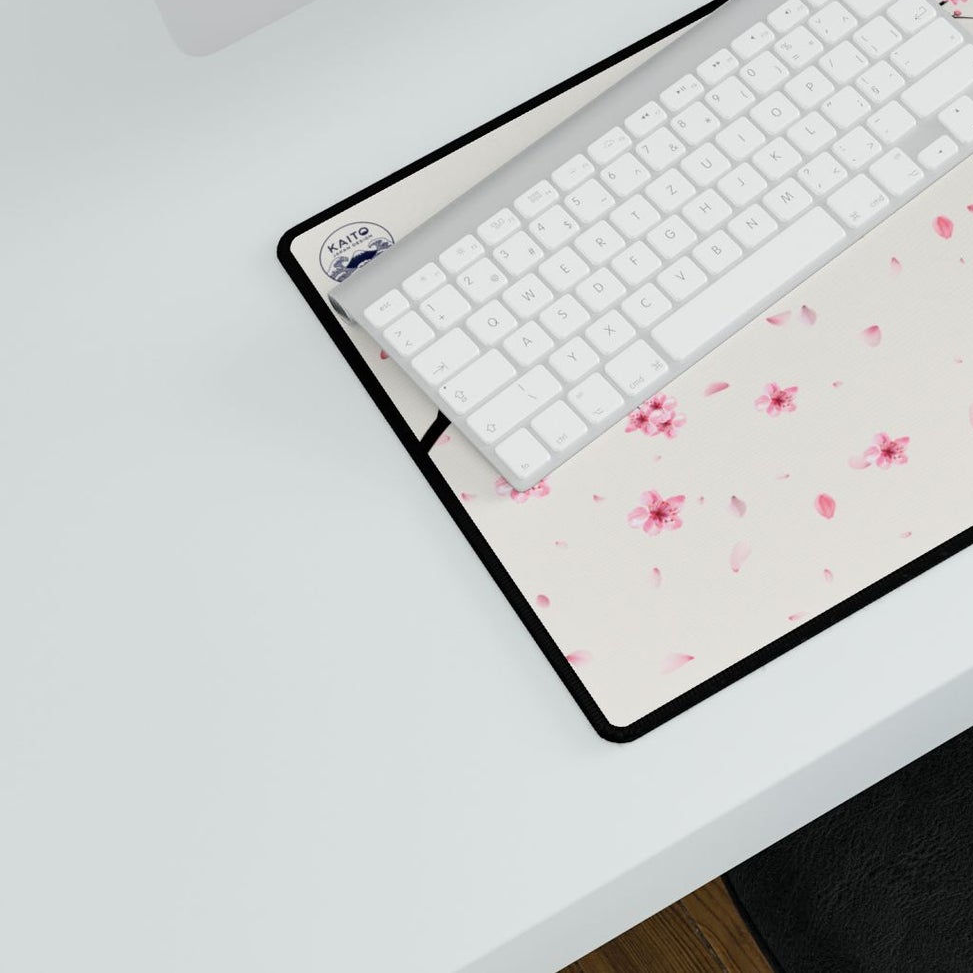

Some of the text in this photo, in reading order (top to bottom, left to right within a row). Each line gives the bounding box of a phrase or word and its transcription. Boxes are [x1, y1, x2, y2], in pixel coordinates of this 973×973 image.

[805, 82, 814, 92] P
[771, 107, 782, 117] O
[769, 151, 782, 161] K
[700, 158, 713, 169] U
[666, 185, 677, 196] Z
[780, 191, 794, 204] M
[699, 202, 712, 213] H
[745, 218, 758, 229] N
[664, 229, 676, 239] G
[327, 226, 369, 253] KAITO
[595, 238, 606, 247] R
[711, 245, 722, 256] B
[629, 256, 637, 266] F
[559, 264, 571, 274] E
[675, 271, 685, 280] V
[592, 283, 604, 293] D
[521, 289, 535, 301] W
[640, 298, 651, 308] C
[557, 309, 568, 319] S
[487, 317, 499, 327] Q
[604, 324, 616, 336] X
[522, 337, 532, 347] A
[567, 352, 577, 361] Y
